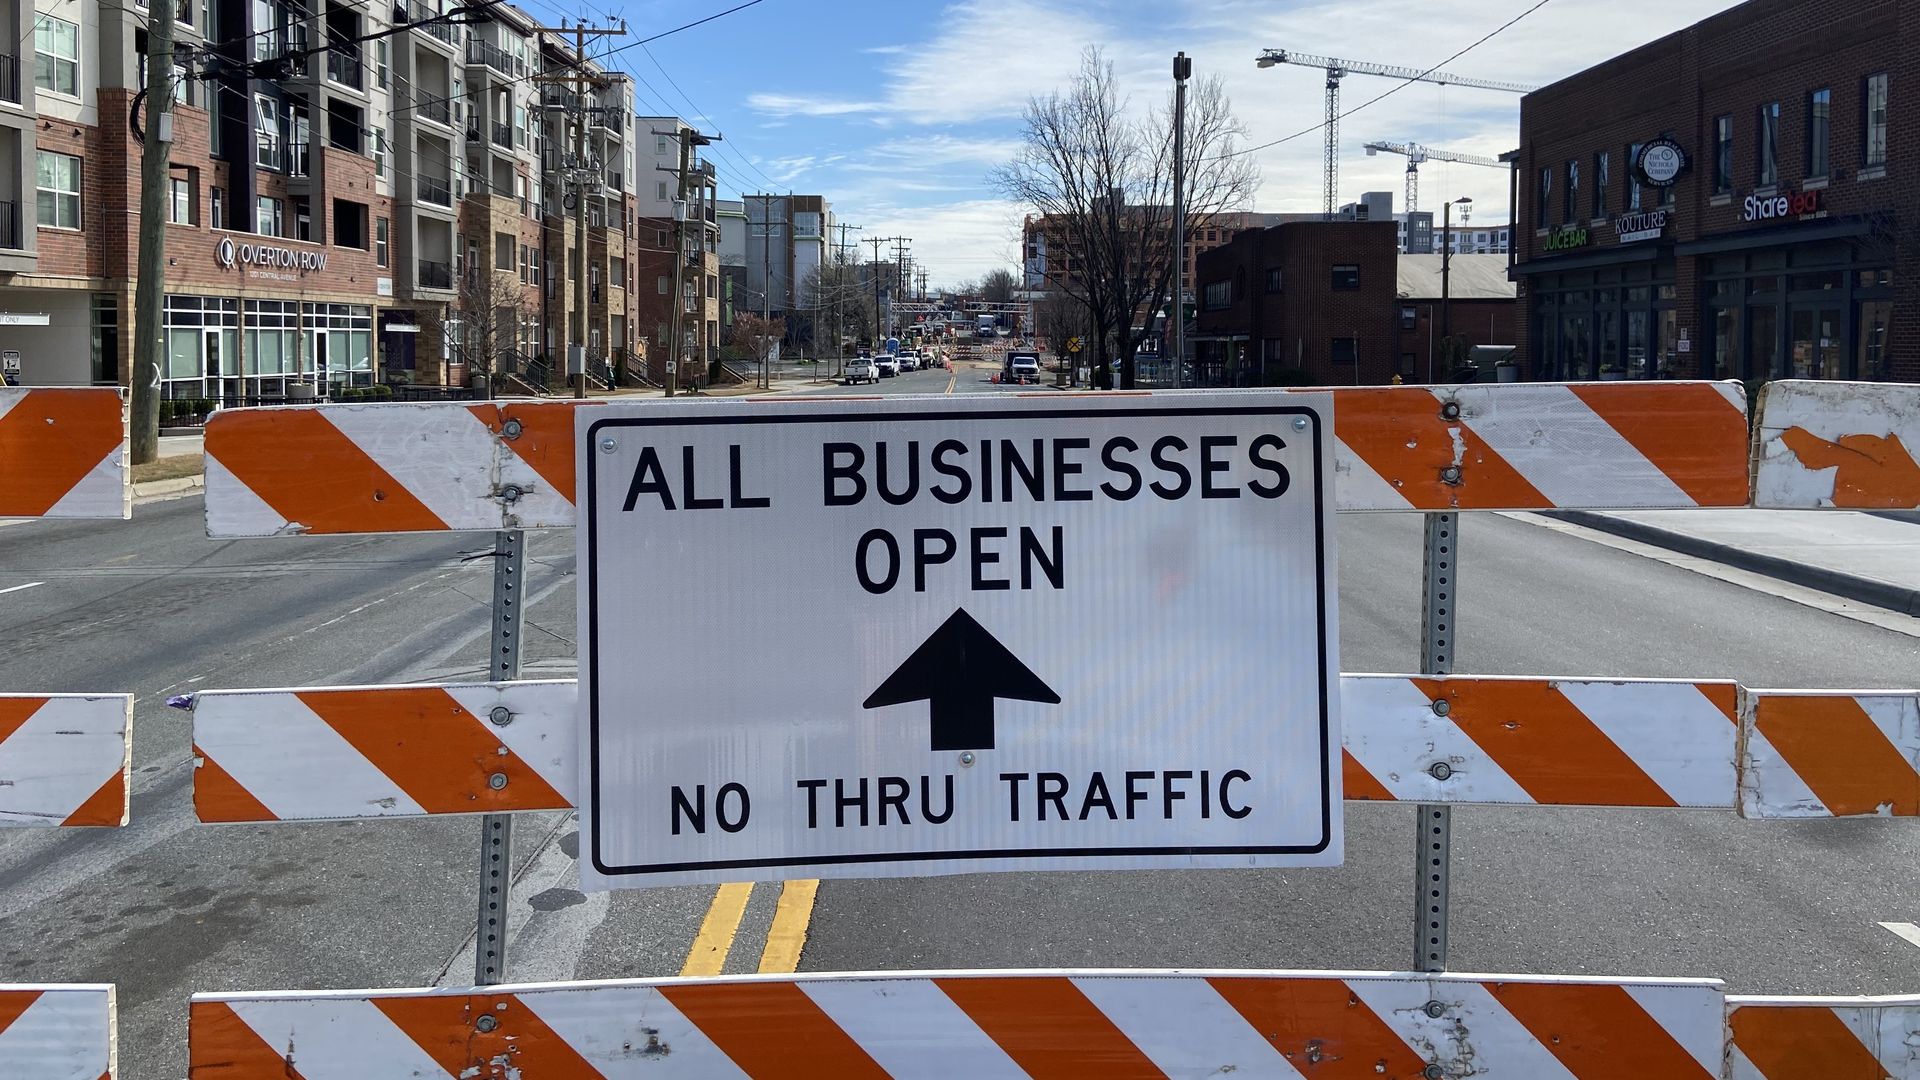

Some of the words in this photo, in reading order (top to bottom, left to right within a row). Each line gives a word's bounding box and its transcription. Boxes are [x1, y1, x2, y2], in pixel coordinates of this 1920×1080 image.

[1649, 153, 1661, 161] THE
[1615, 210, 1666, 235] KOUTURE
[241, 243, 299, 268] OVERTON
[301, 250, 328, 271] ROW
[623, 446, 770, 512] ALL
[823, 434, 1291, 506] BUSINESSES
[855, 526, 1065, 595] OPEN
[671, 783, 751, 836] NO
[797, 774, 955, 830] THRU
[1000, 769, 1253, 822] TRAFFIC
